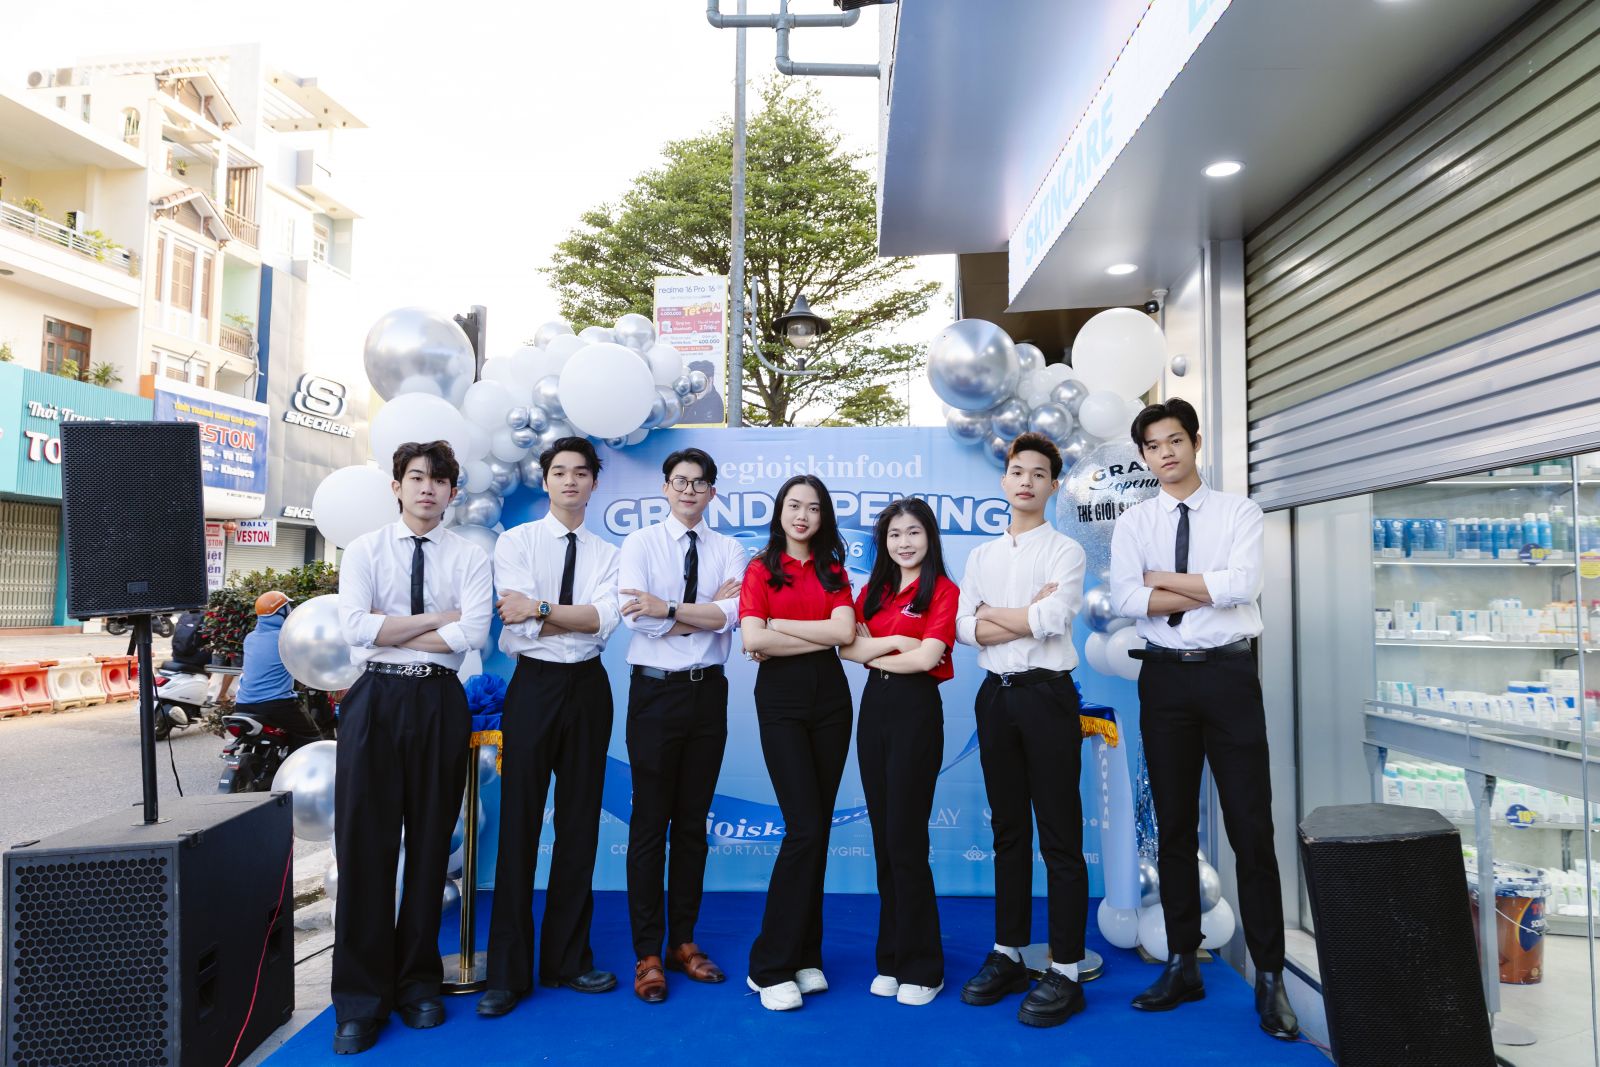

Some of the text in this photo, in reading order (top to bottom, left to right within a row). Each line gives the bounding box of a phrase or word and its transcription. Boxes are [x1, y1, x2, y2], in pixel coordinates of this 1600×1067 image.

[1025, 93, 1113, 266] SKINCARE
[28, 400, 59, 420] Thời
[284, 411, 357, 438] SKECHERS
[199, 422, 256, 451] ESTON
[720, 454, 923, 484] egioiskinfood
[1092, 461, 1150, 482] GRA
[604, 490, 1010, 536] GRND PEING
[1077, 501, 1093, 522] THẾ
[1095, 500, 1116, 521] GIỚI
[236, 530, 270, 542] VESTON
[207, 550, 222, 562] iệt
[708, 845, 781, 856] MORTALS
[830, 847, 871, 856] YGIRL
